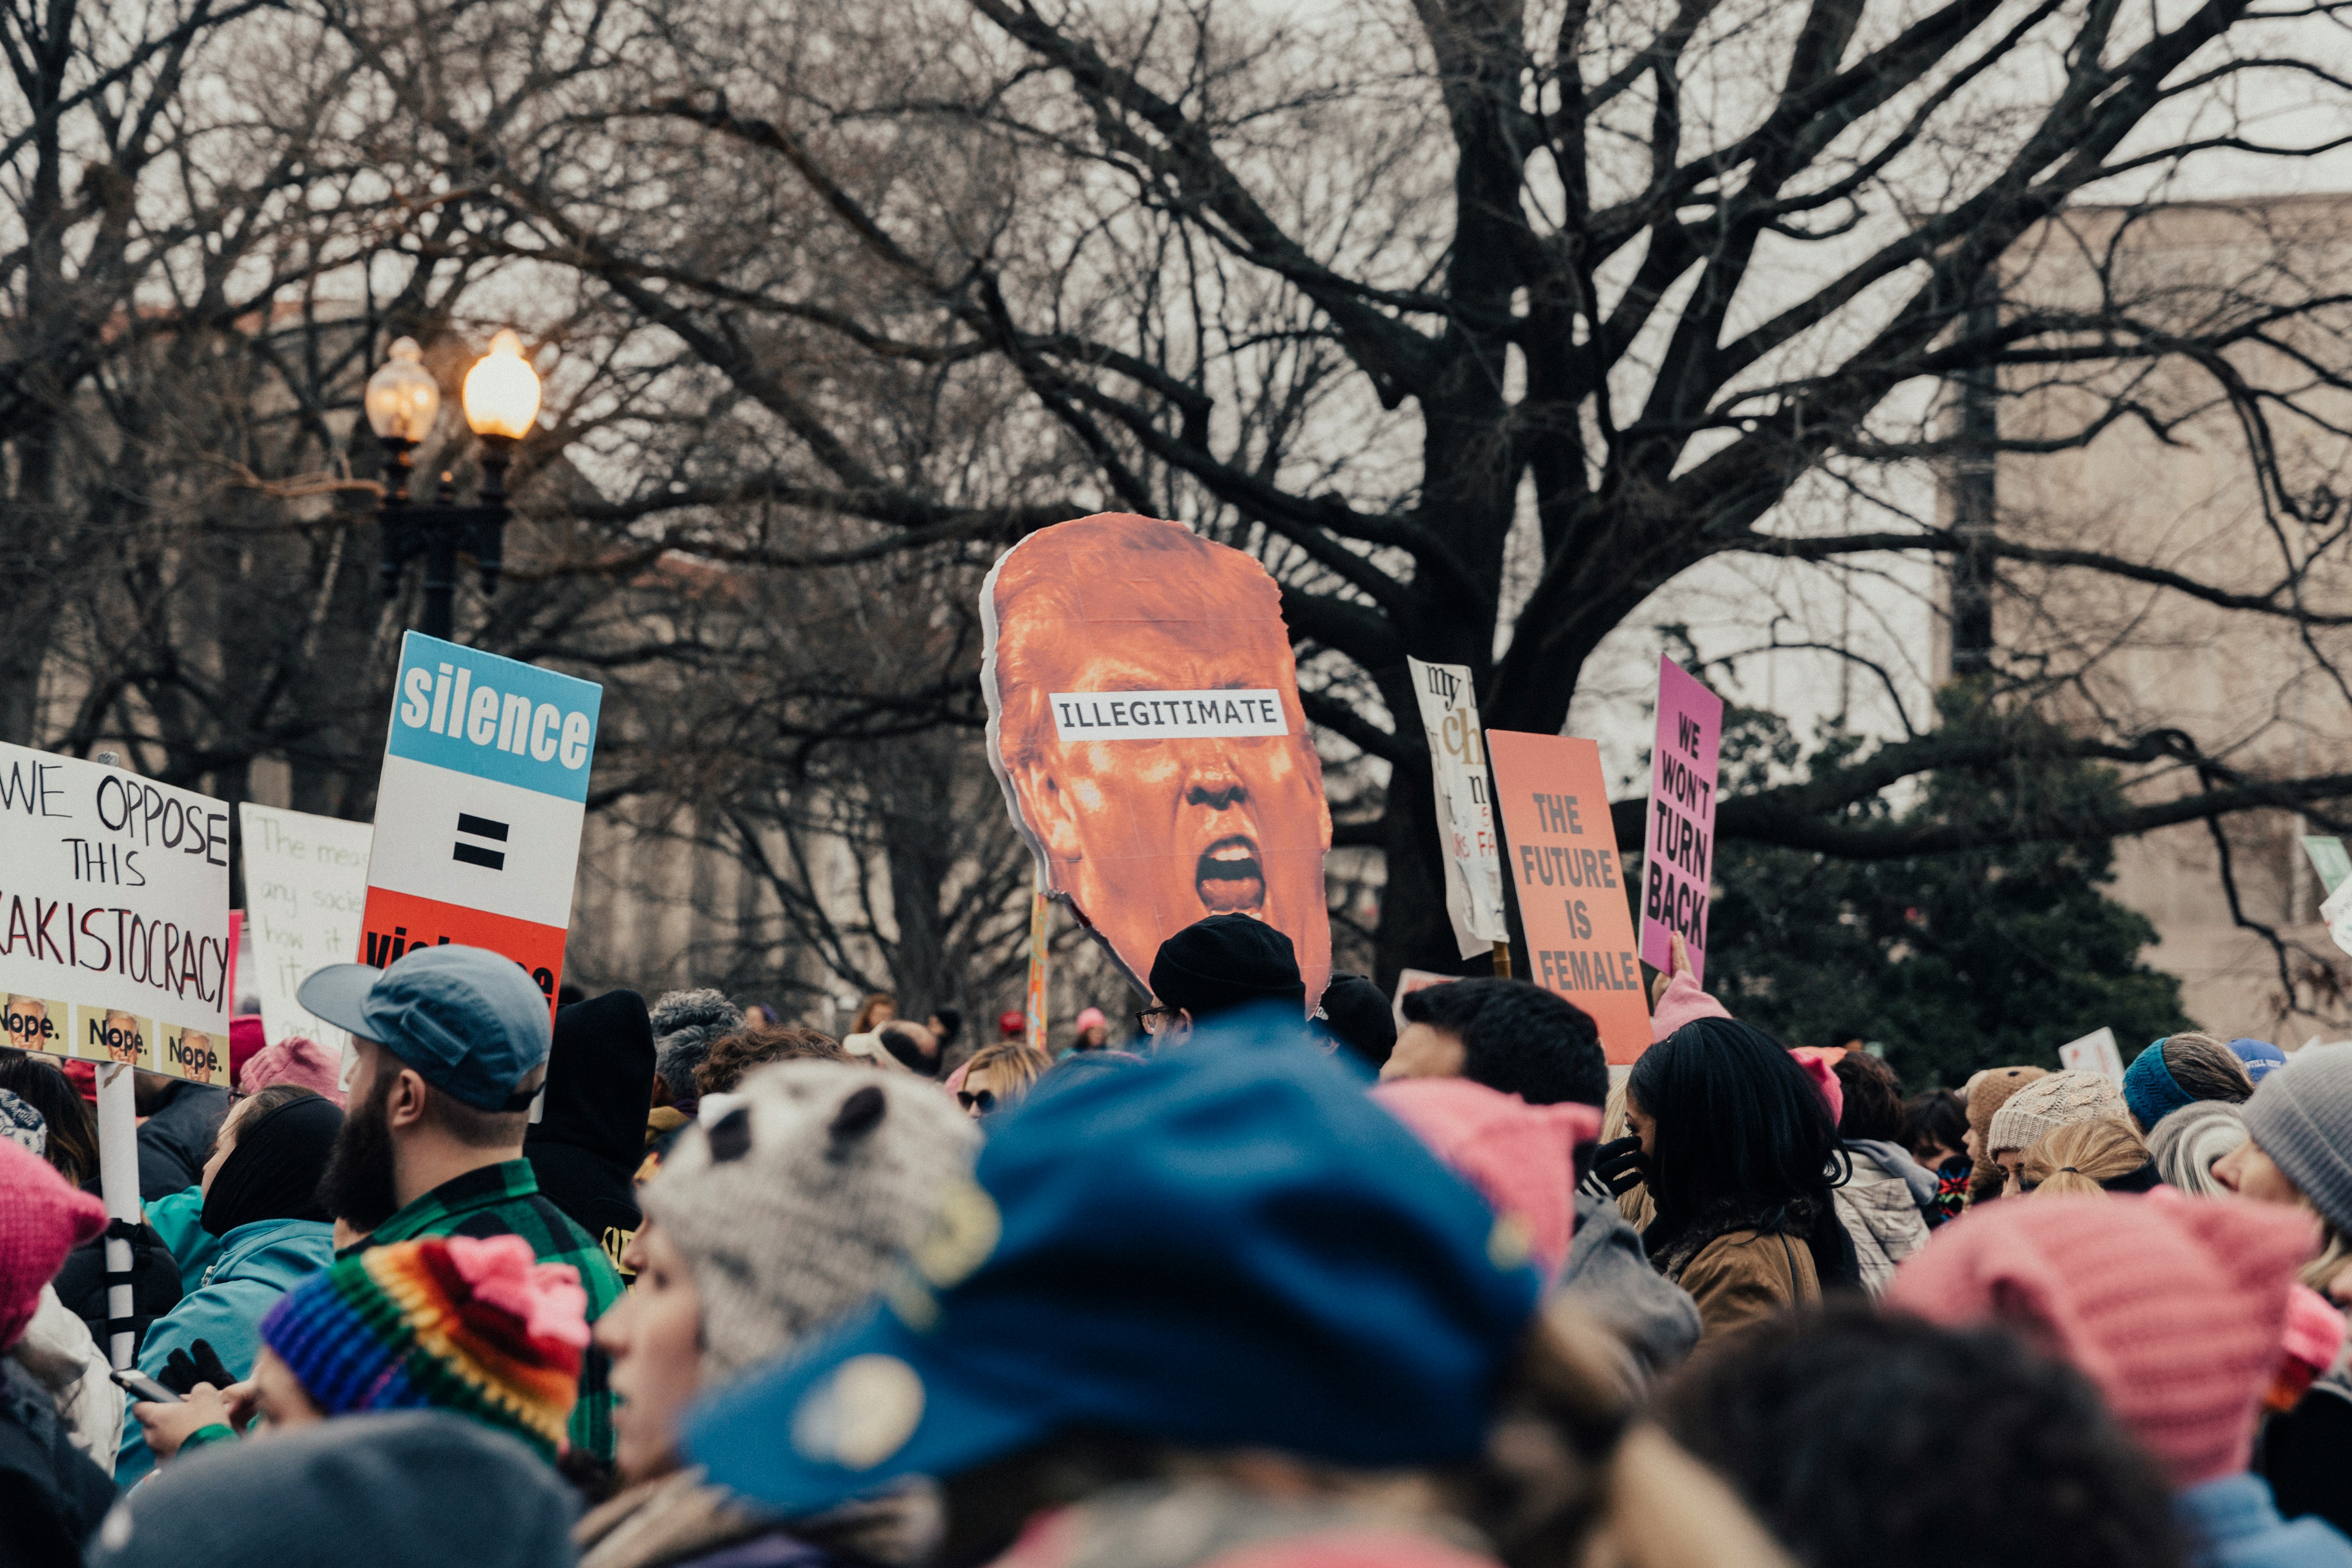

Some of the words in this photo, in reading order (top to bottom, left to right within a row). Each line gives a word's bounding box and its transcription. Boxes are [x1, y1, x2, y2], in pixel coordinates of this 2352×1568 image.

[401, 662, 590, 770] silence
[1060, 699, 1277, 727] ILLEGITIMATE
[1679, 711, 1701, 760] WE
[1662, 750, 1709, 819] WON'T
[0, 760, 72, 818] WE
[97, 775, 227, 867] OPPOSE
[1533, 792, 1583, 835] THE
[61, 838, 146, 886] THIS
[1656, 799, 1707, 882] TURN
[1519, 845, 1616, 888] FUTURE
[1565, 900, 1592, 940] IS
[1647, 860, 1705, 950] BACK
[1538, 951, 1638, 991] FEMALE
[89, 1018, 147, 1056] Nope.
[169, 1036, 222, 1074] Nope.
